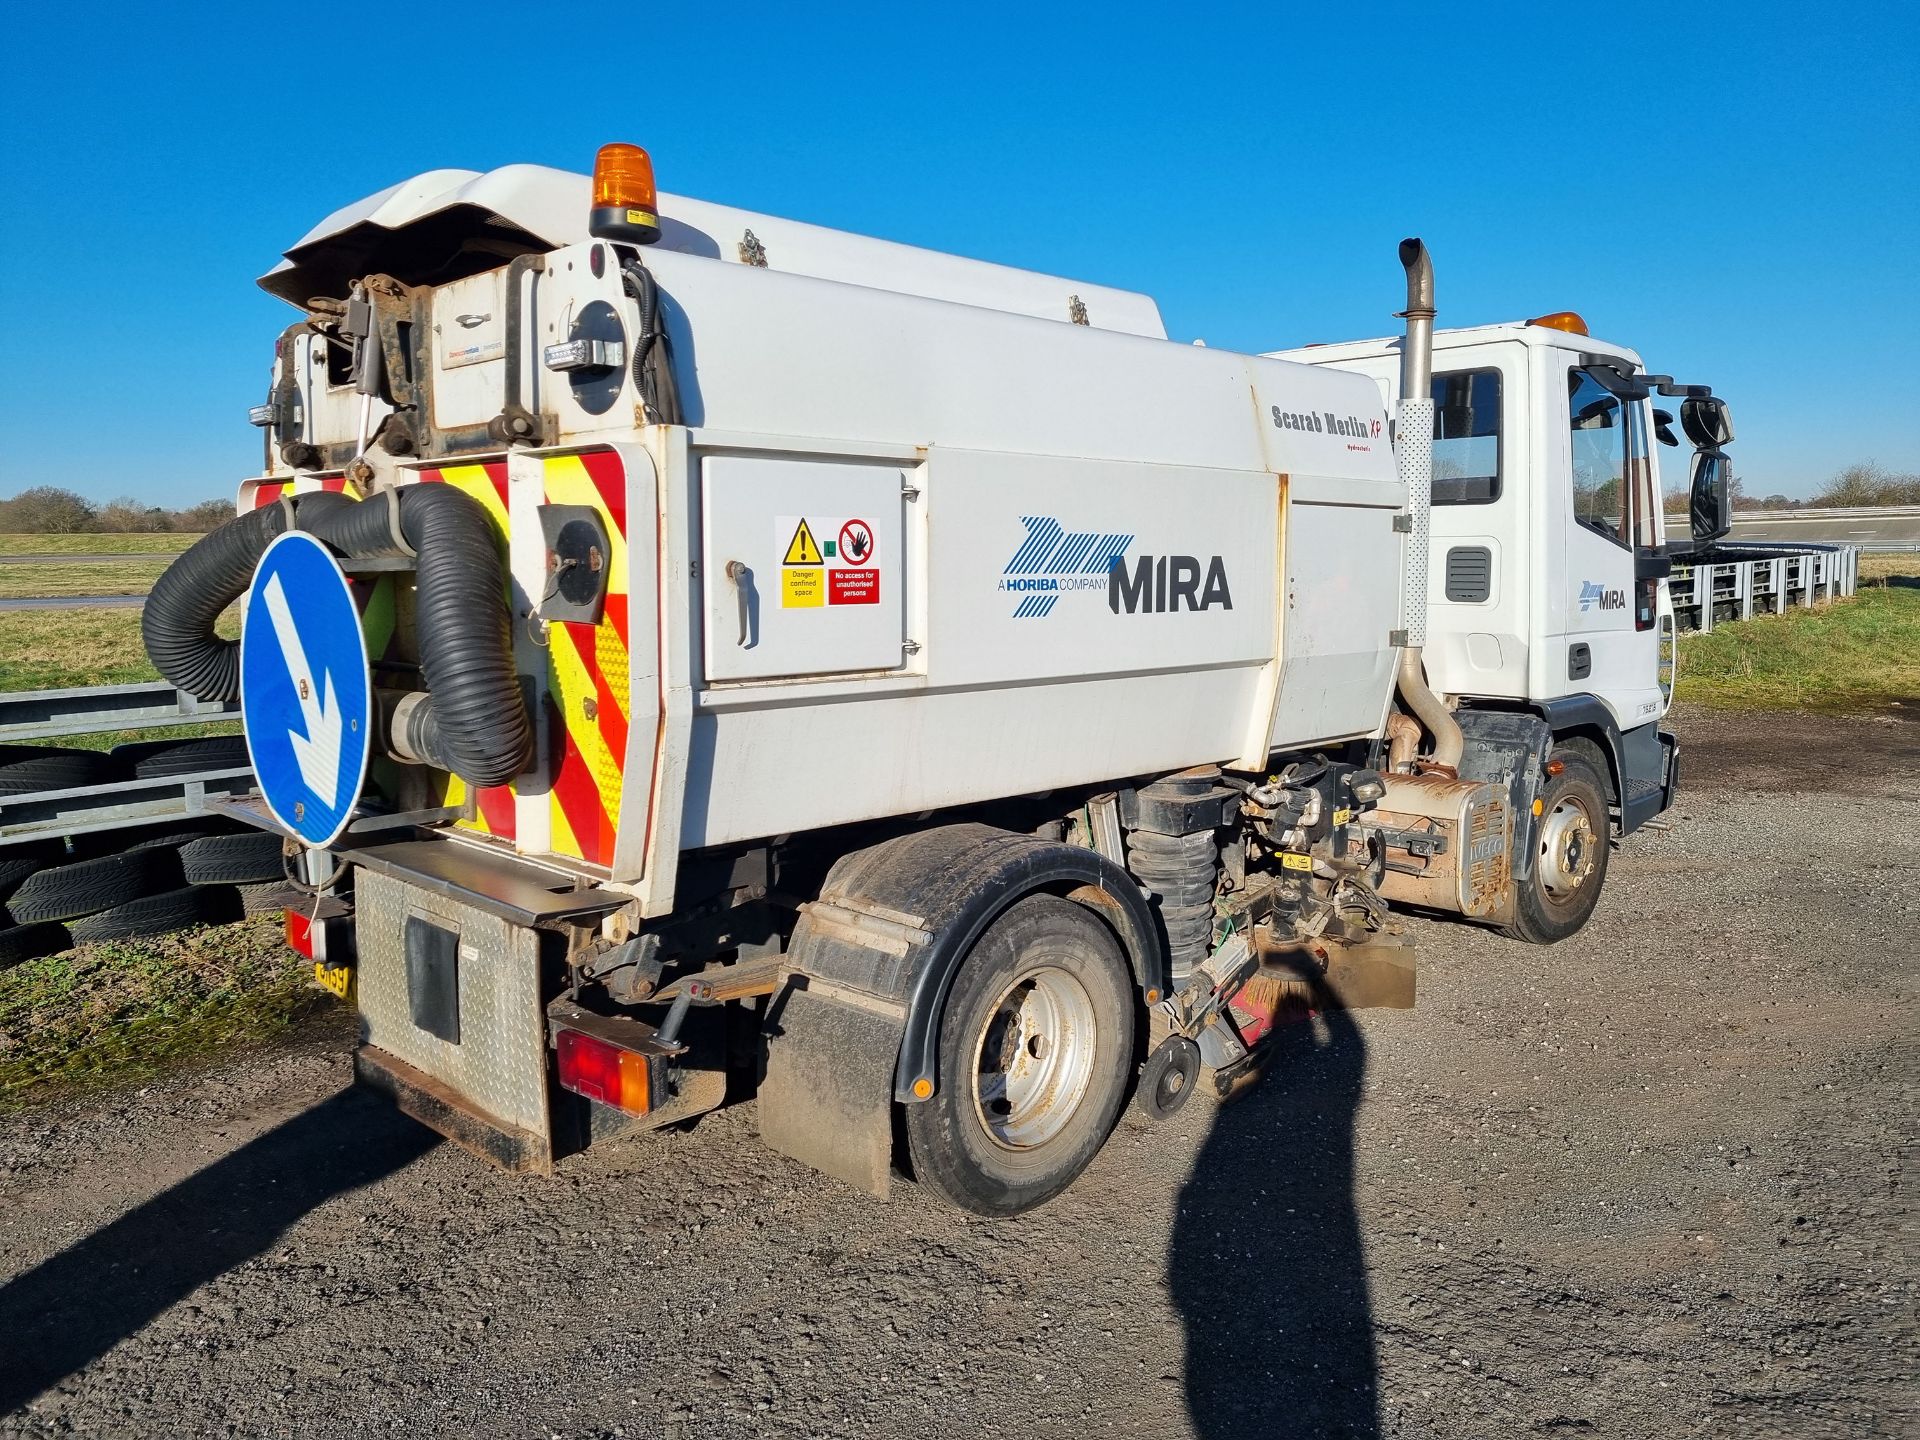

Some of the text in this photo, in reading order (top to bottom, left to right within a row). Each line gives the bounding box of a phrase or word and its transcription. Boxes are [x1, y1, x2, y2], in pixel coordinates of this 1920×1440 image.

[1271, 405, 1382, 439] Scarab Merlin XP
[792, 571, 814, 579] Danger
[835, 571, 844, 579] No
[865, 571, 874, 579] for
[790, 579, 816, 587] confined
[997, 578, 1108, 592] A HORIBA COMPANY
[1108, 555, 1233, 615] MIRA
[795, 589, 812, 597] space
[843, 589, 866, 597] persons
[1599, 589, 1626, 610] MIRA
